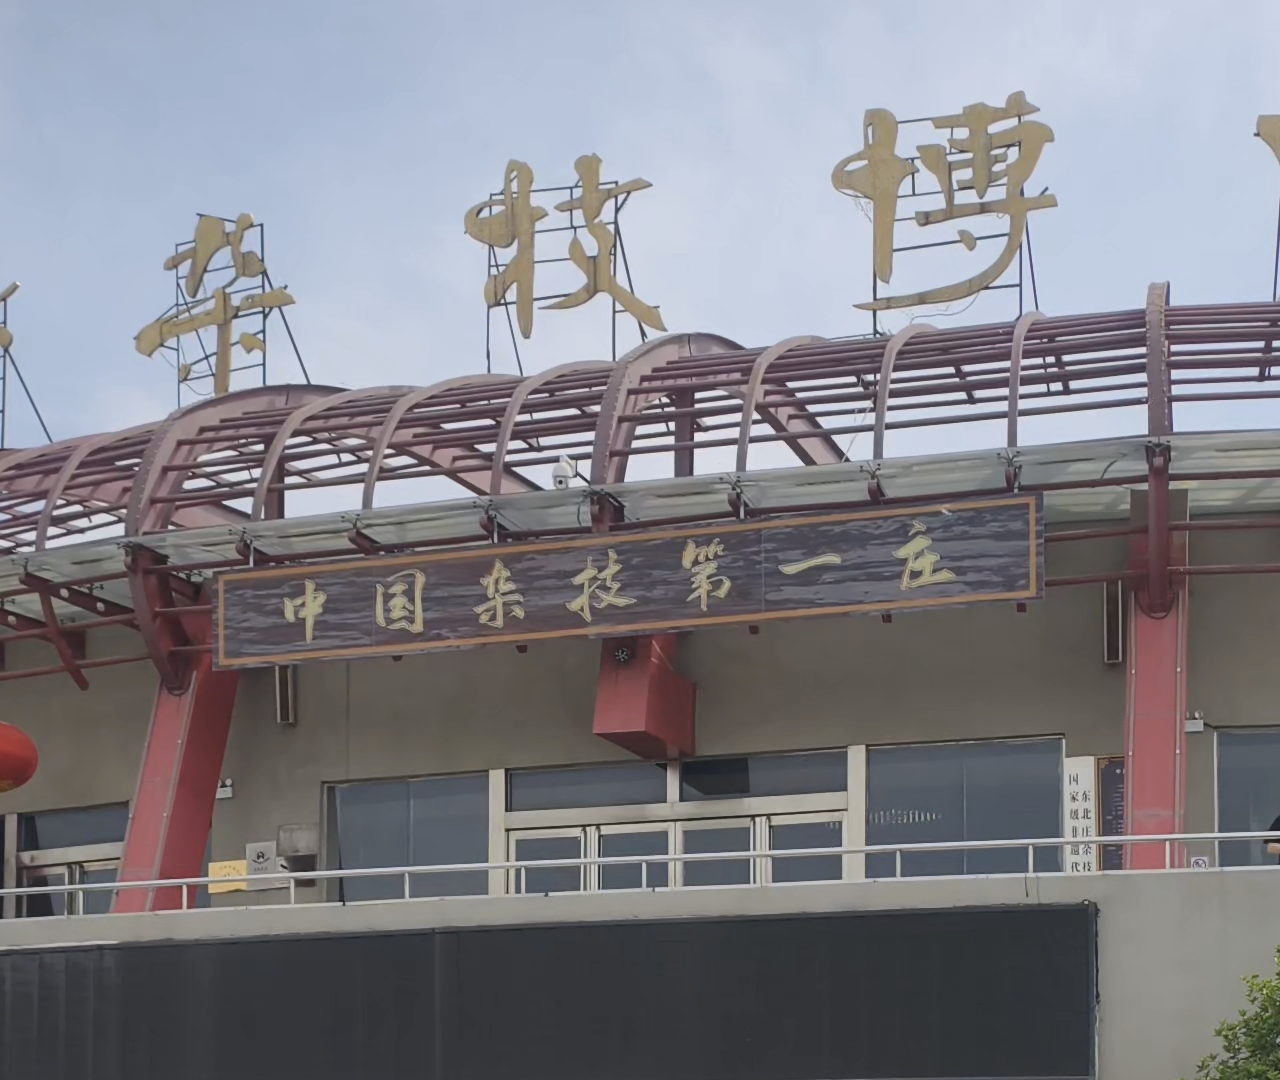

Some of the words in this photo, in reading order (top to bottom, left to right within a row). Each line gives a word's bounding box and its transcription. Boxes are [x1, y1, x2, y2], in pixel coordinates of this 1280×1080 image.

[282, 519, 956, 643] 中国杂技第一庄
